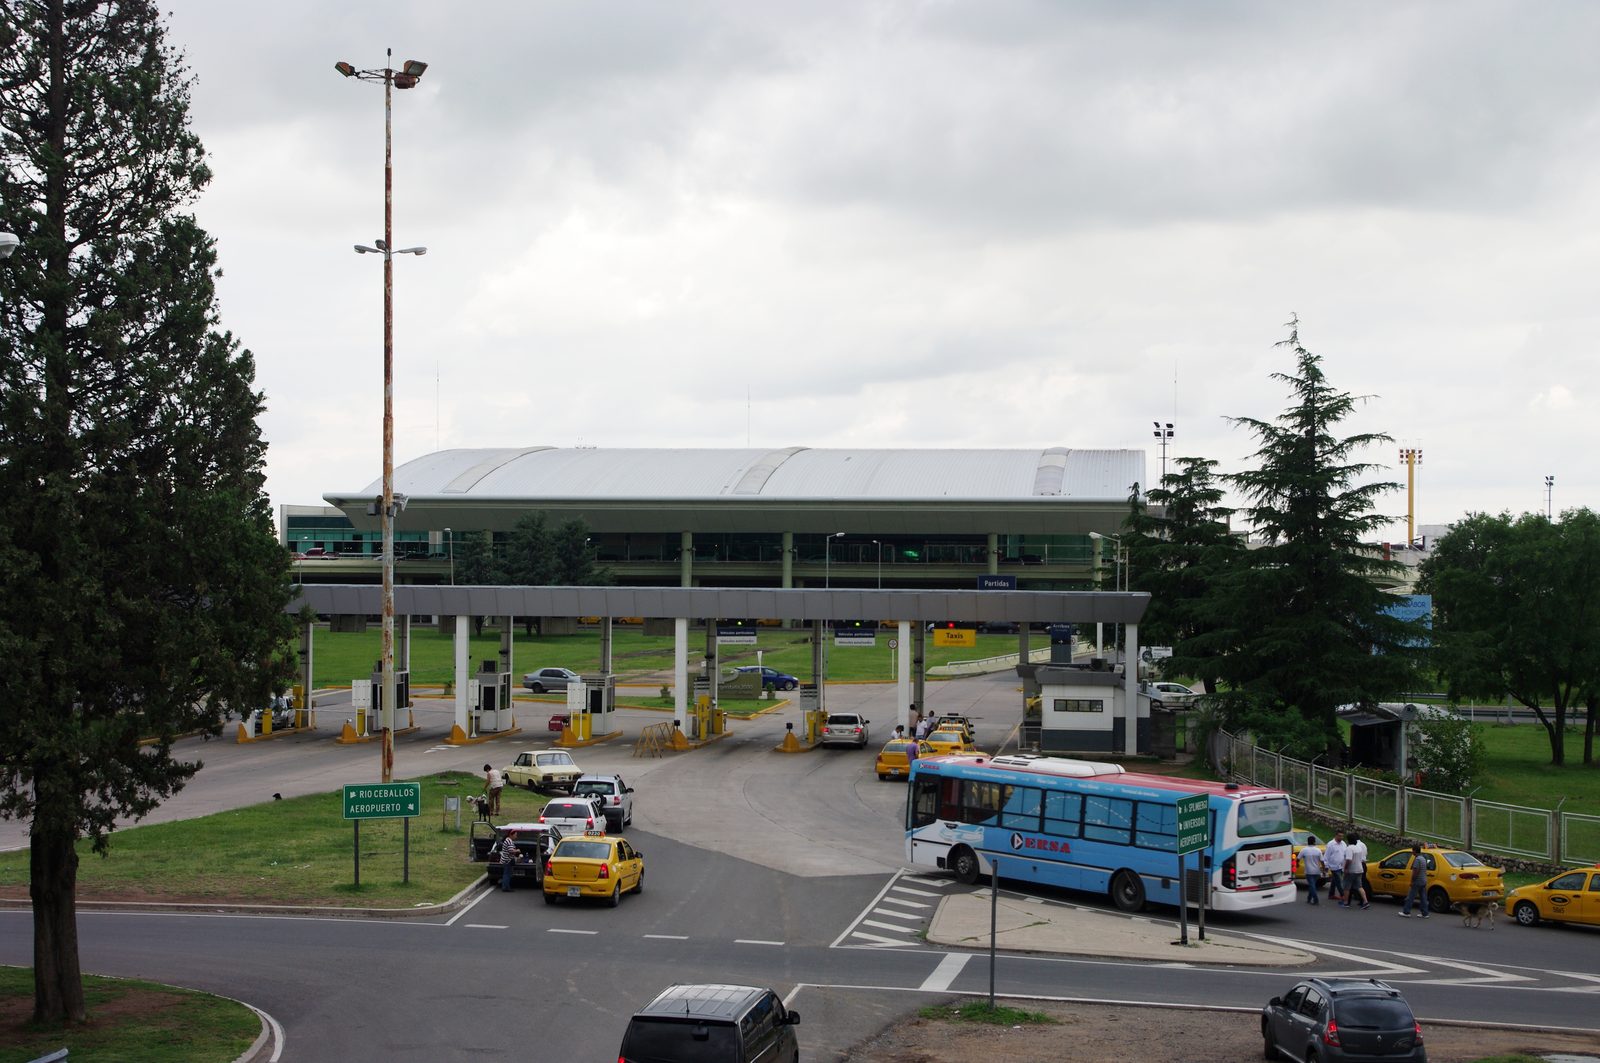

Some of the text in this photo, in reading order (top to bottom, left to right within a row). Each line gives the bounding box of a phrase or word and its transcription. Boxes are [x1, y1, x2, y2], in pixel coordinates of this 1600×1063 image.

[359, 788, 414, 798] RIO CEBALLOS
[350, 803, 400, 814] AEROPUERTO
[1025, 837, 1072, 854] ERSA
[1180, 833, 1202, 848] AEROPUERTO
